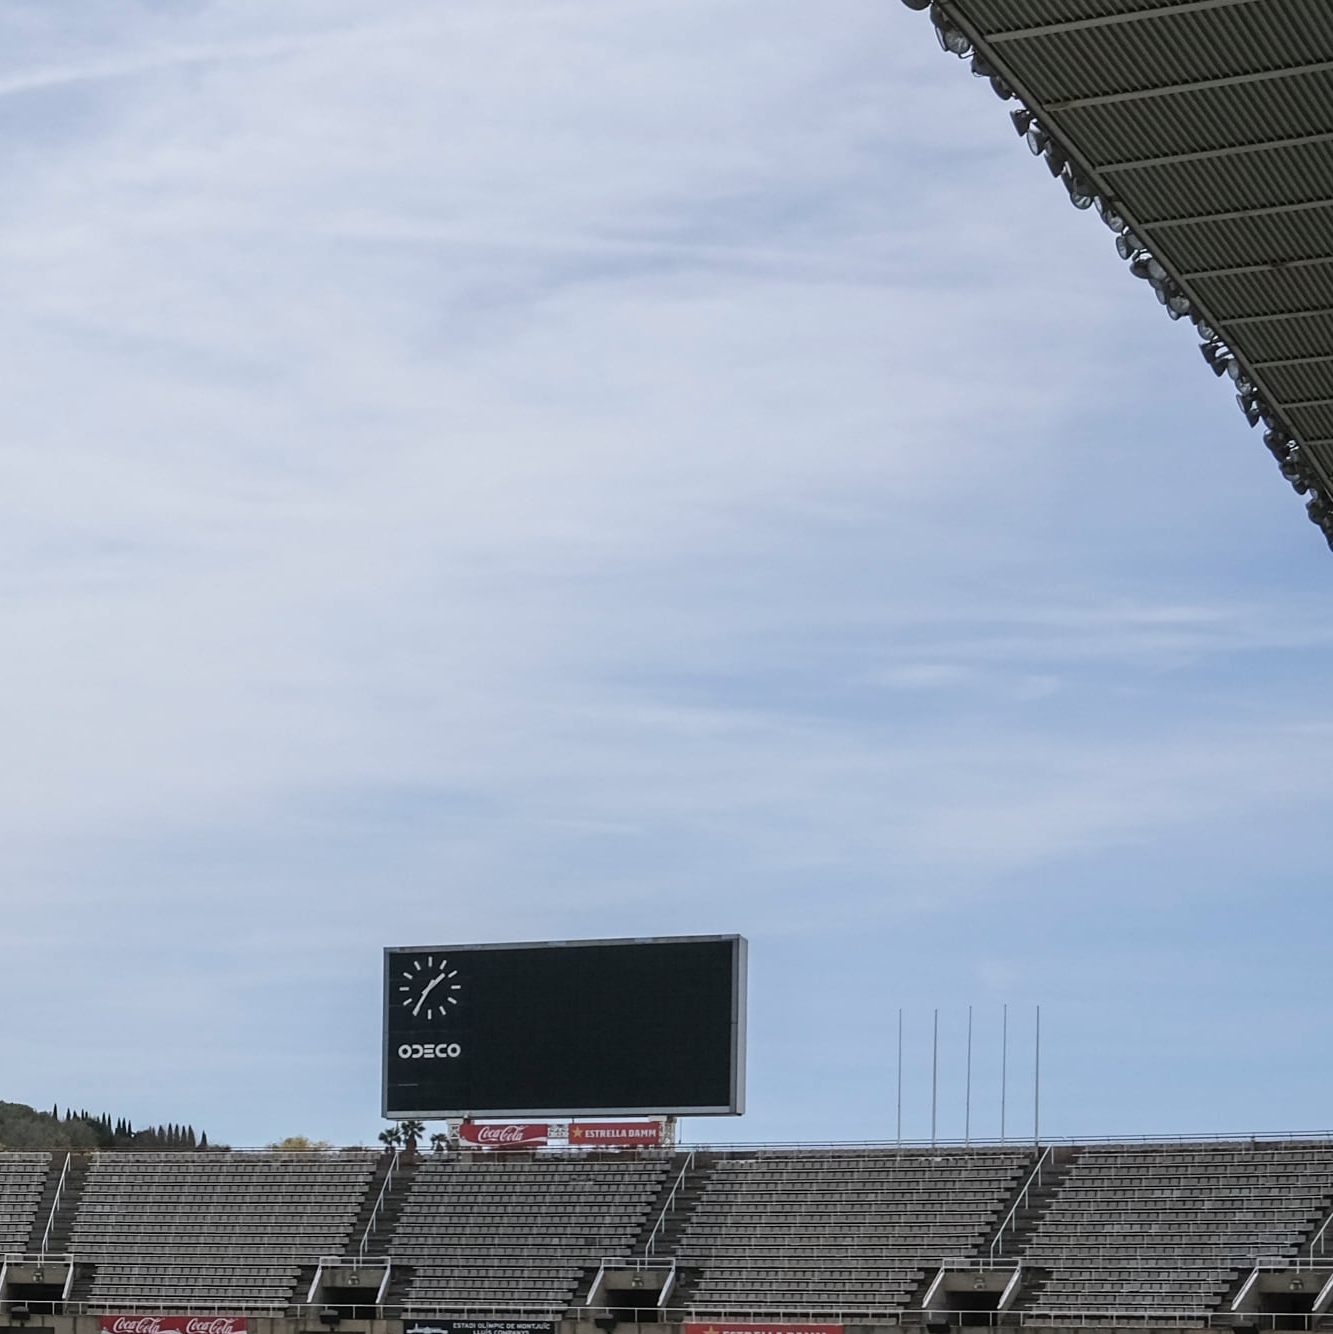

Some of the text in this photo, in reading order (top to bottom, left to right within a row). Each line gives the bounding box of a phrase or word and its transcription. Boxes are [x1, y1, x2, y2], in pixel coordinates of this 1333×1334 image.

[398, 1043, 461, 1059] ODECO
[585, 1128, 656, 1138] ESTRELLA DAMM
